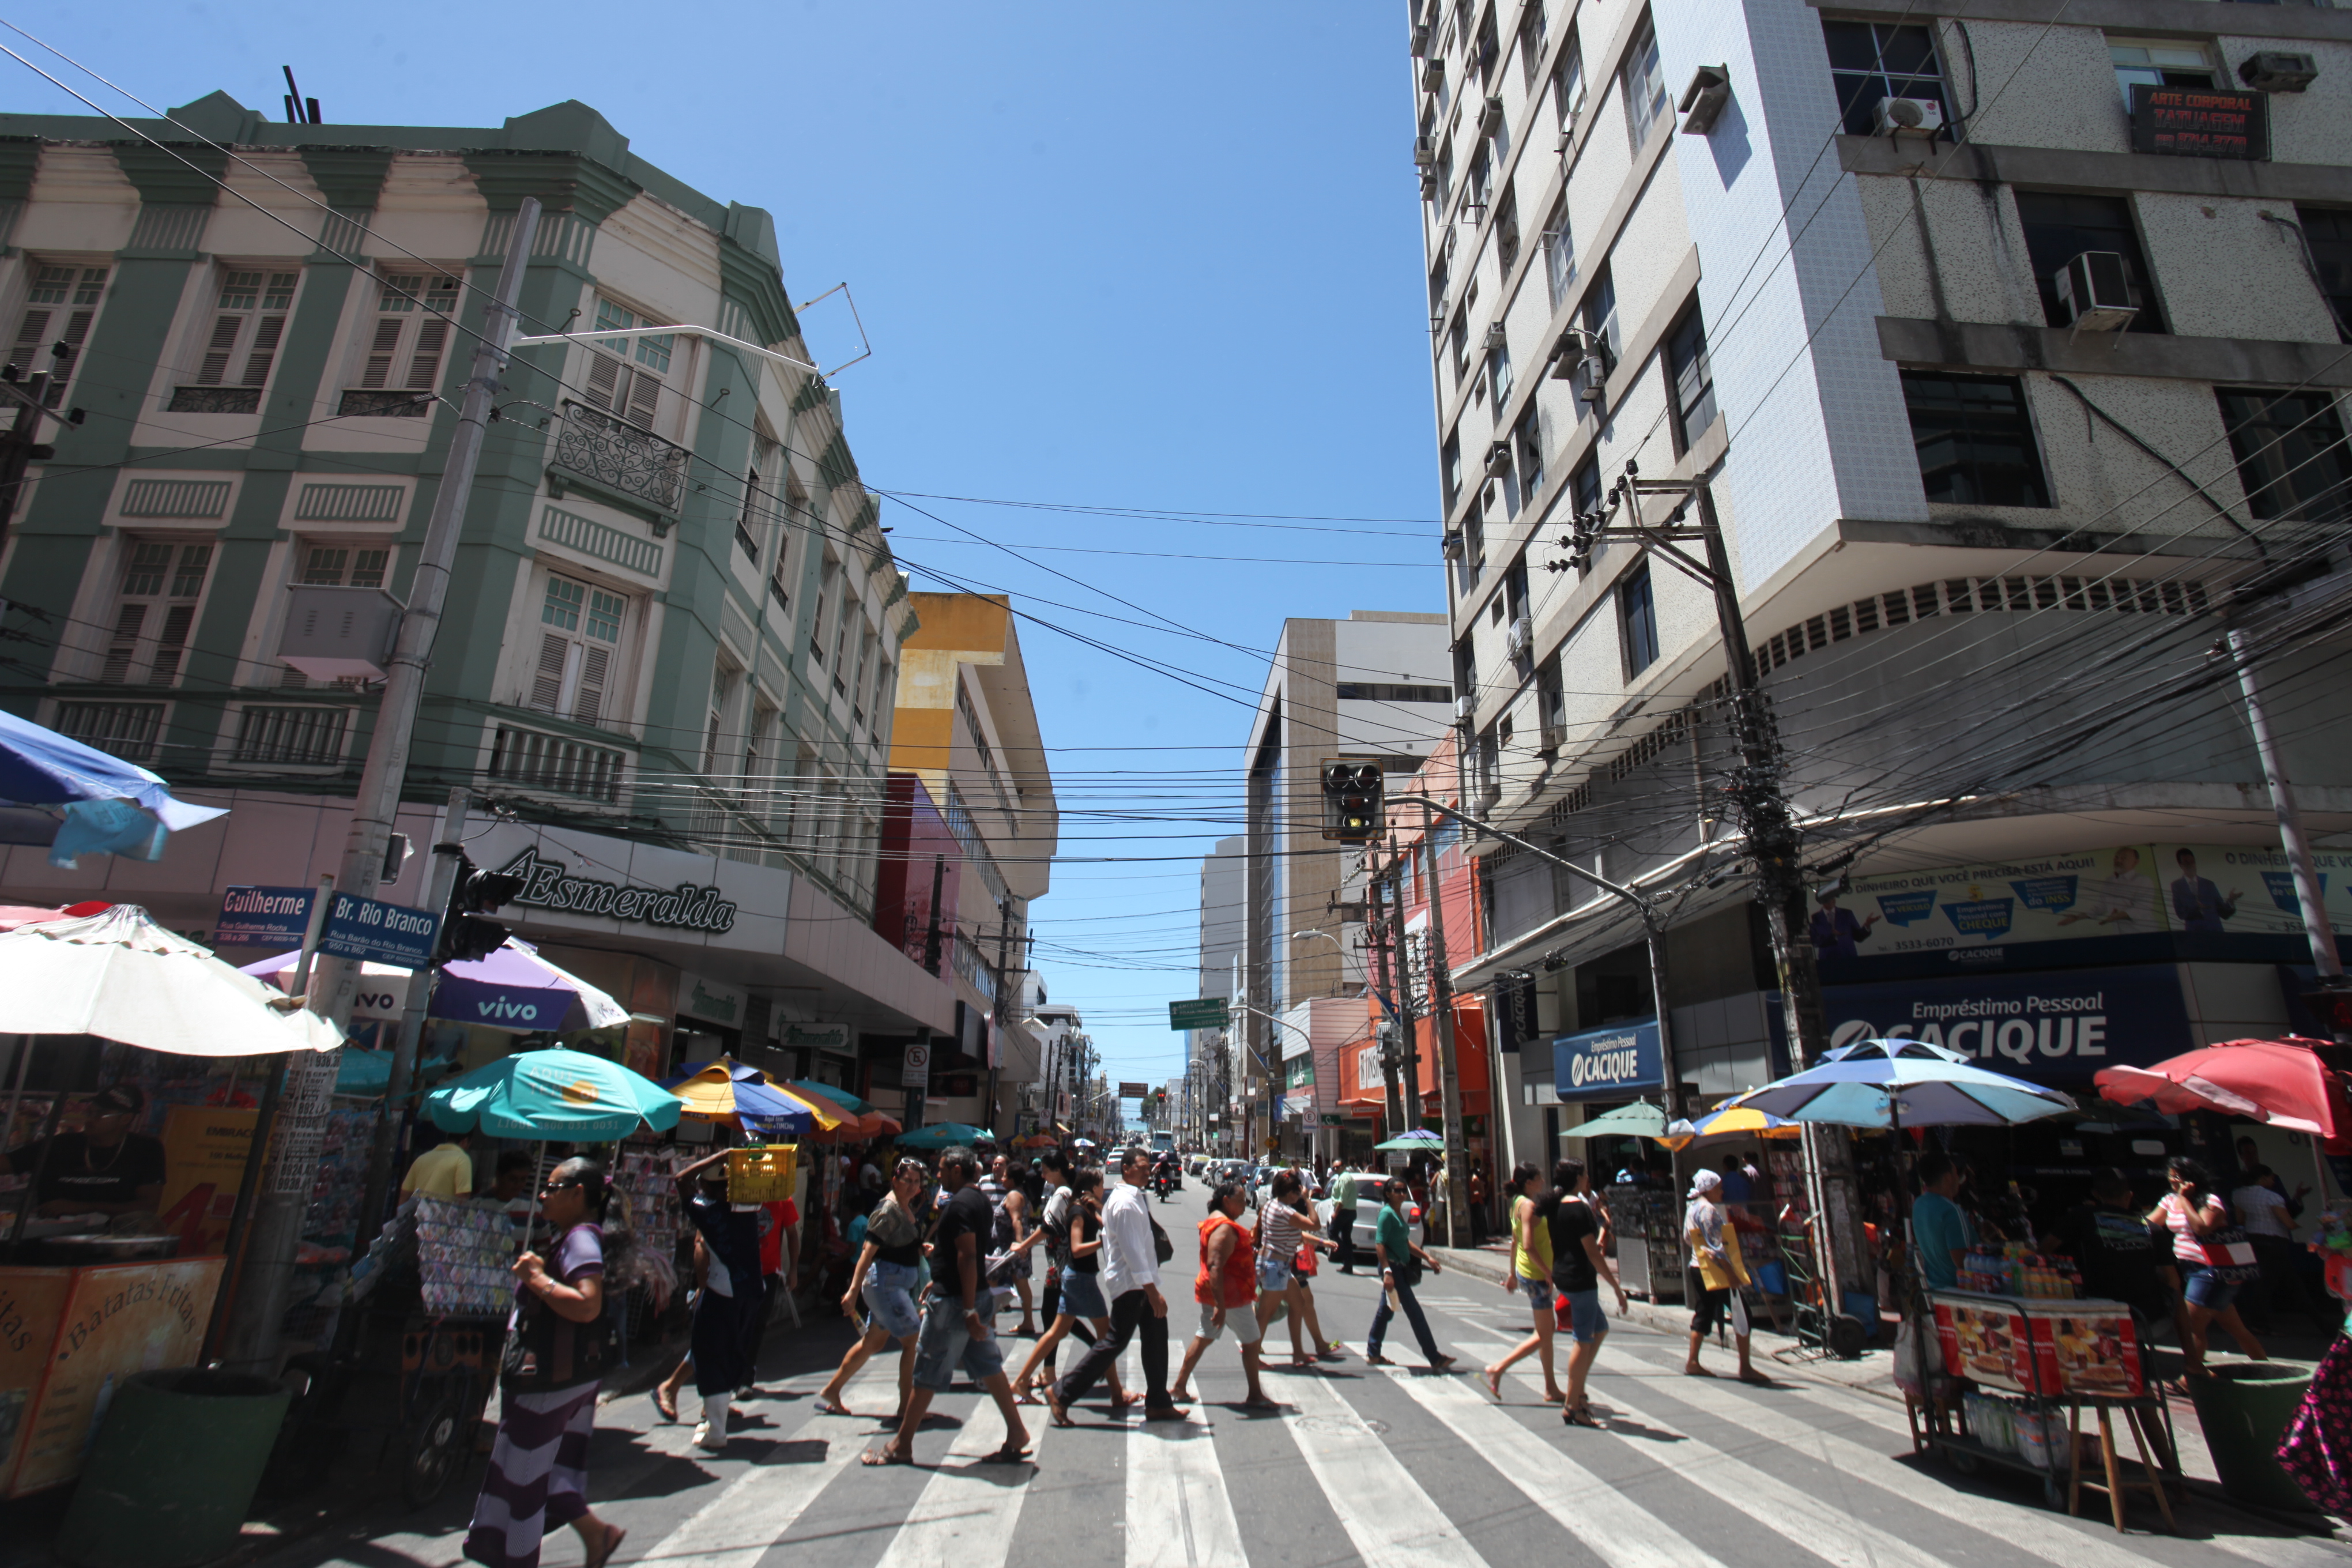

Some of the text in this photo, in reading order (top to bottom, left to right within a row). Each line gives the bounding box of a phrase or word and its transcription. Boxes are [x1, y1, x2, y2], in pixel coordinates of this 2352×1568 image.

[2149, 92, 2253, 111] ARTE CORPORAL
[2154, 108, 2246, 133] TATUAGEM
[2226, 853, 2235, 864] O
[2239, 853, 2289, 865] DINHEI
[2310, 855, 2336, 868] QUE
[1856, 879, 1909, 893] DINHEIRO
[1912, 876, 1936, 887] QUE
[1938, 870, 1970, 883] VOCÊ
[1973, 866, 2021, 880] PRECISA
[2024, 861, 2053, 873] ESTÁ
[2057, 857, 2095, 871] AQUI!
[224, 890, 305, 915] Guilherme
[510, 862, 737, 933] Esmeralda
[2029, 895, 2071, 906] do INSS
[335, 897, 432, 936] Br. Rio Branco
[1958, 913, 1987, 921] Pessoal
[1959, 917, 2008, 930] CHEQUE
[235, 922, 265, 930] Guilherme
[266, 924, 287, 932] Rocha
[328, 941, 343, 951] 950
[330, 930, 423, 955] Rua Barão do Rio Branco
[1895, 937, 1954, 950] 3533-6070
[1961, 948, 2004, 959] CACIQUE
[477, 996, 537, 1020] vivo
[1514, 979, 1526, 1031] CACIQUE
[1912, 992, 2104, 1021] Empréstimo Pessoal
[1591, 1033, 1636, 1054] Empréstimo Pessoal
[529, 1066, 573, 1081] AQUI
[1585, 1049, 1637, 1084] CACIQUE
[568, 1121, 587, 1130] 031
[2215, 1268, 2260, 1281] TOMMY
[67, 1273, 197, 1351] Batatas Fritas
